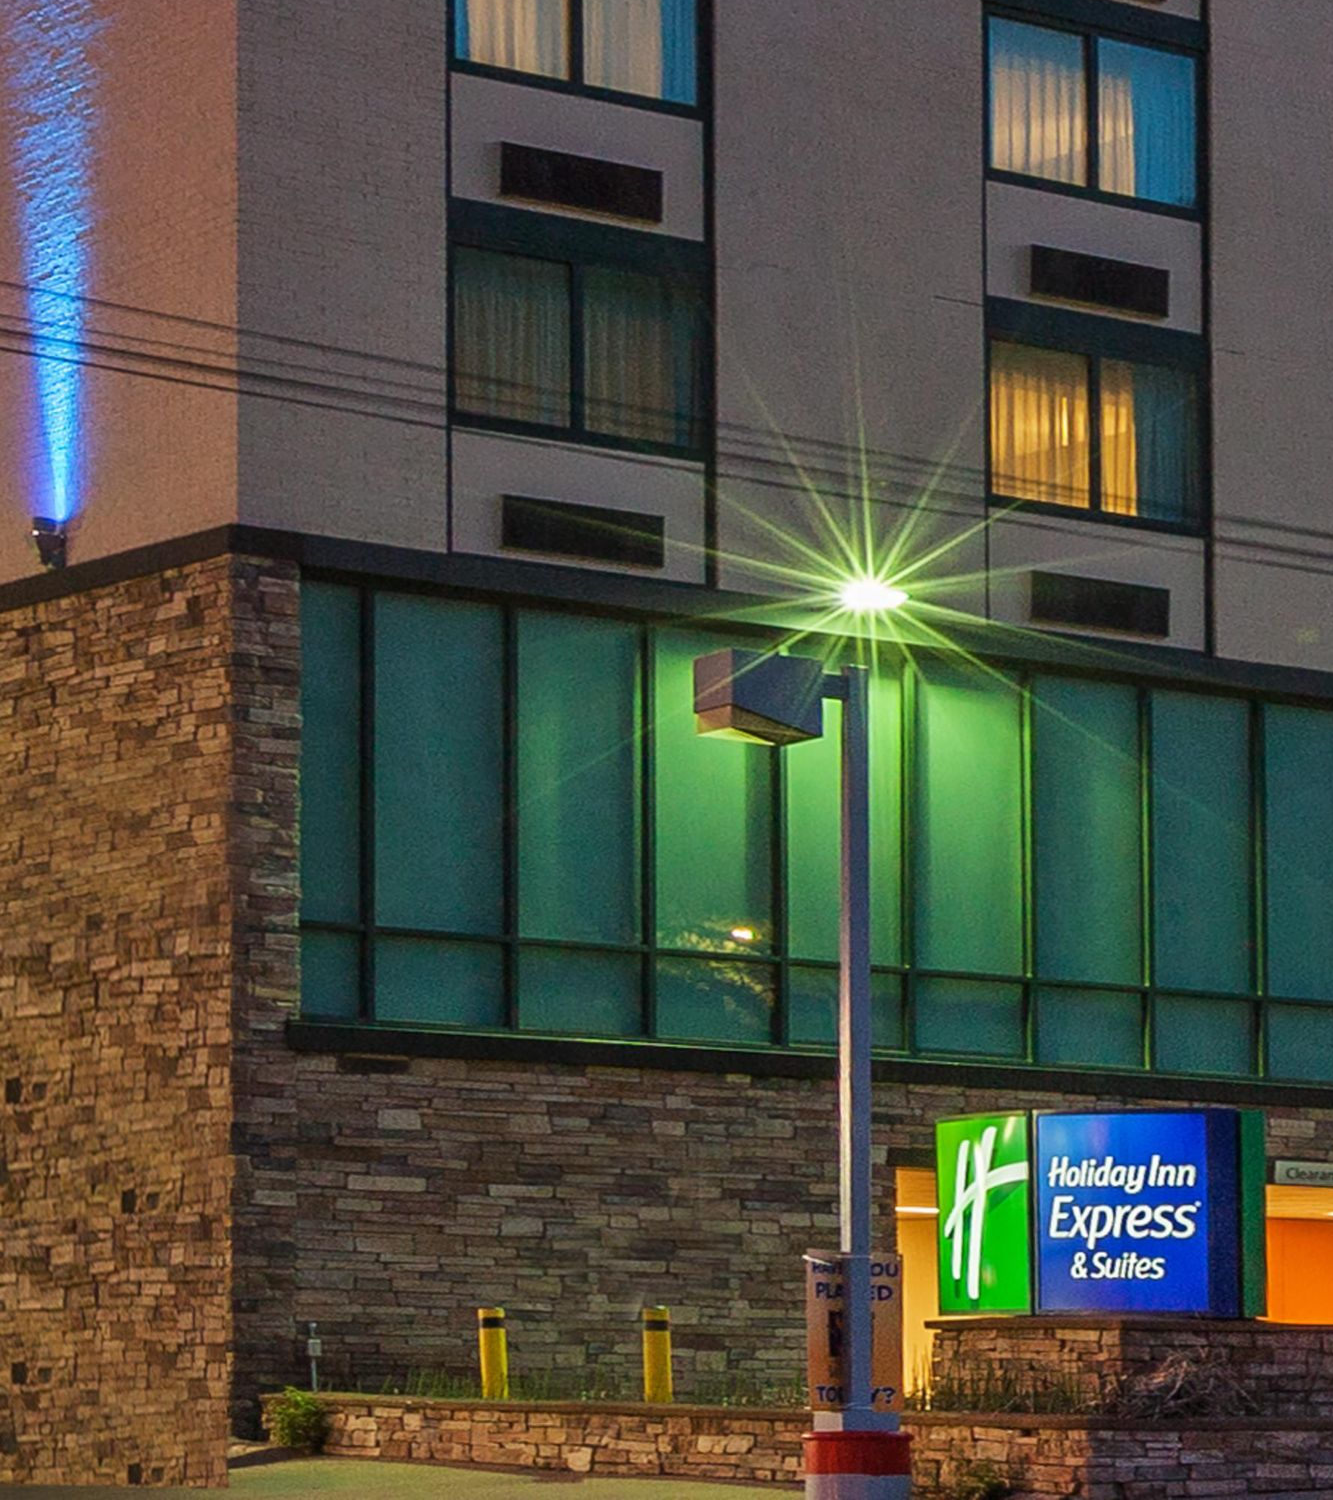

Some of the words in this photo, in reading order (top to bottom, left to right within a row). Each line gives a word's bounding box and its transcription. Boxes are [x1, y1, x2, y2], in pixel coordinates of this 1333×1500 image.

[1048, 1155, 1147, 1194] Holiday
[1149, 1154, 1196, 1187] Inn
[1049, 1194, 1197, 1251] Express
[1070, 1253, 1089, 1280] &
[1090, 1252, 1166, 1280] Suites
